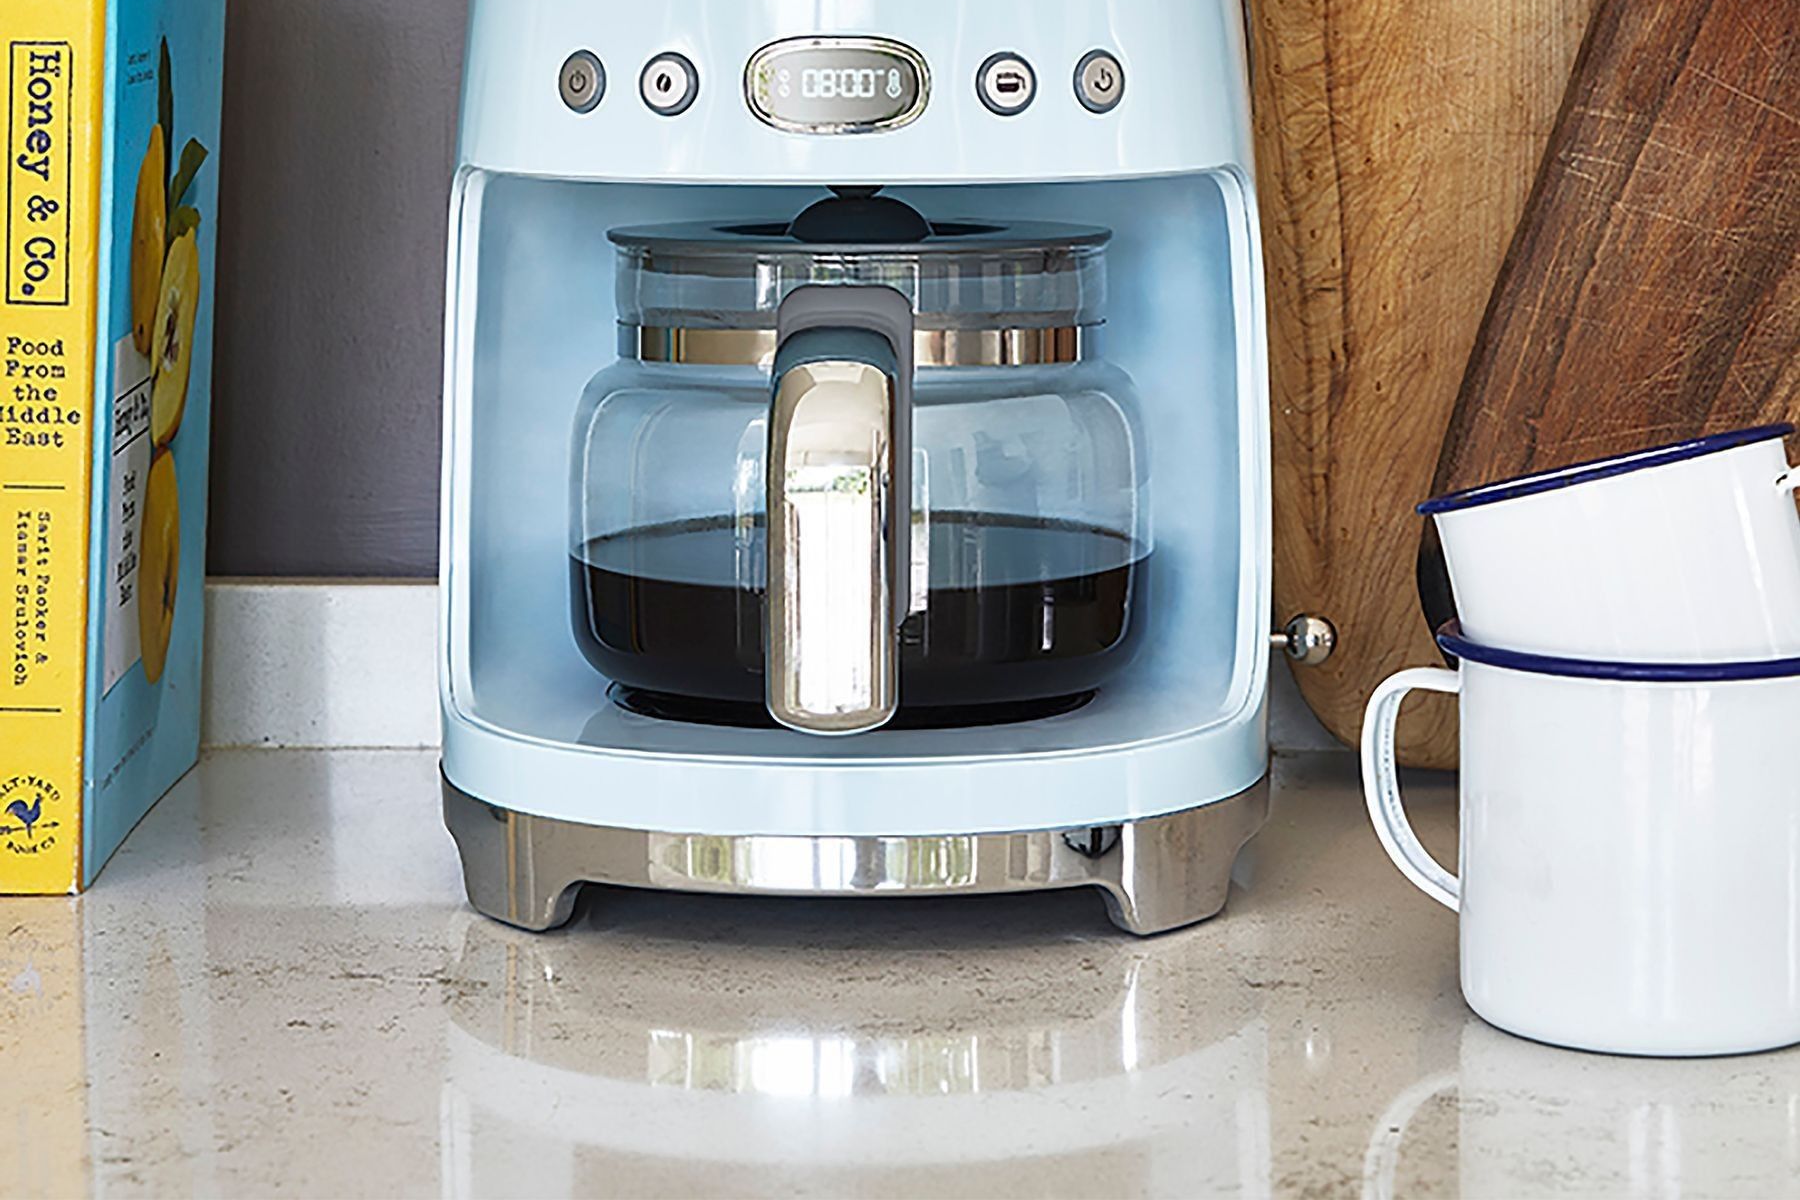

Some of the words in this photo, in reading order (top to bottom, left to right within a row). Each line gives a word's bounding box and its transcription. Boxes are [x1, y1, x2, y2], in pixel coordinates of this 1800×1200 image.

[802, 68, 875, 98] 08:00
[17, 51, 61, 182] Honey
[27, 195, 60, 223] &
[22, 237, 56, 296] Co.
[7, 337, 64, 356] Food
[6, 360, 65, 378] From
[13, 384, 57, 401] the
[0, 406, 80, 424] iddle
[6, 428, 63, 448] East
[37, 511, 50, 566] Sarit
